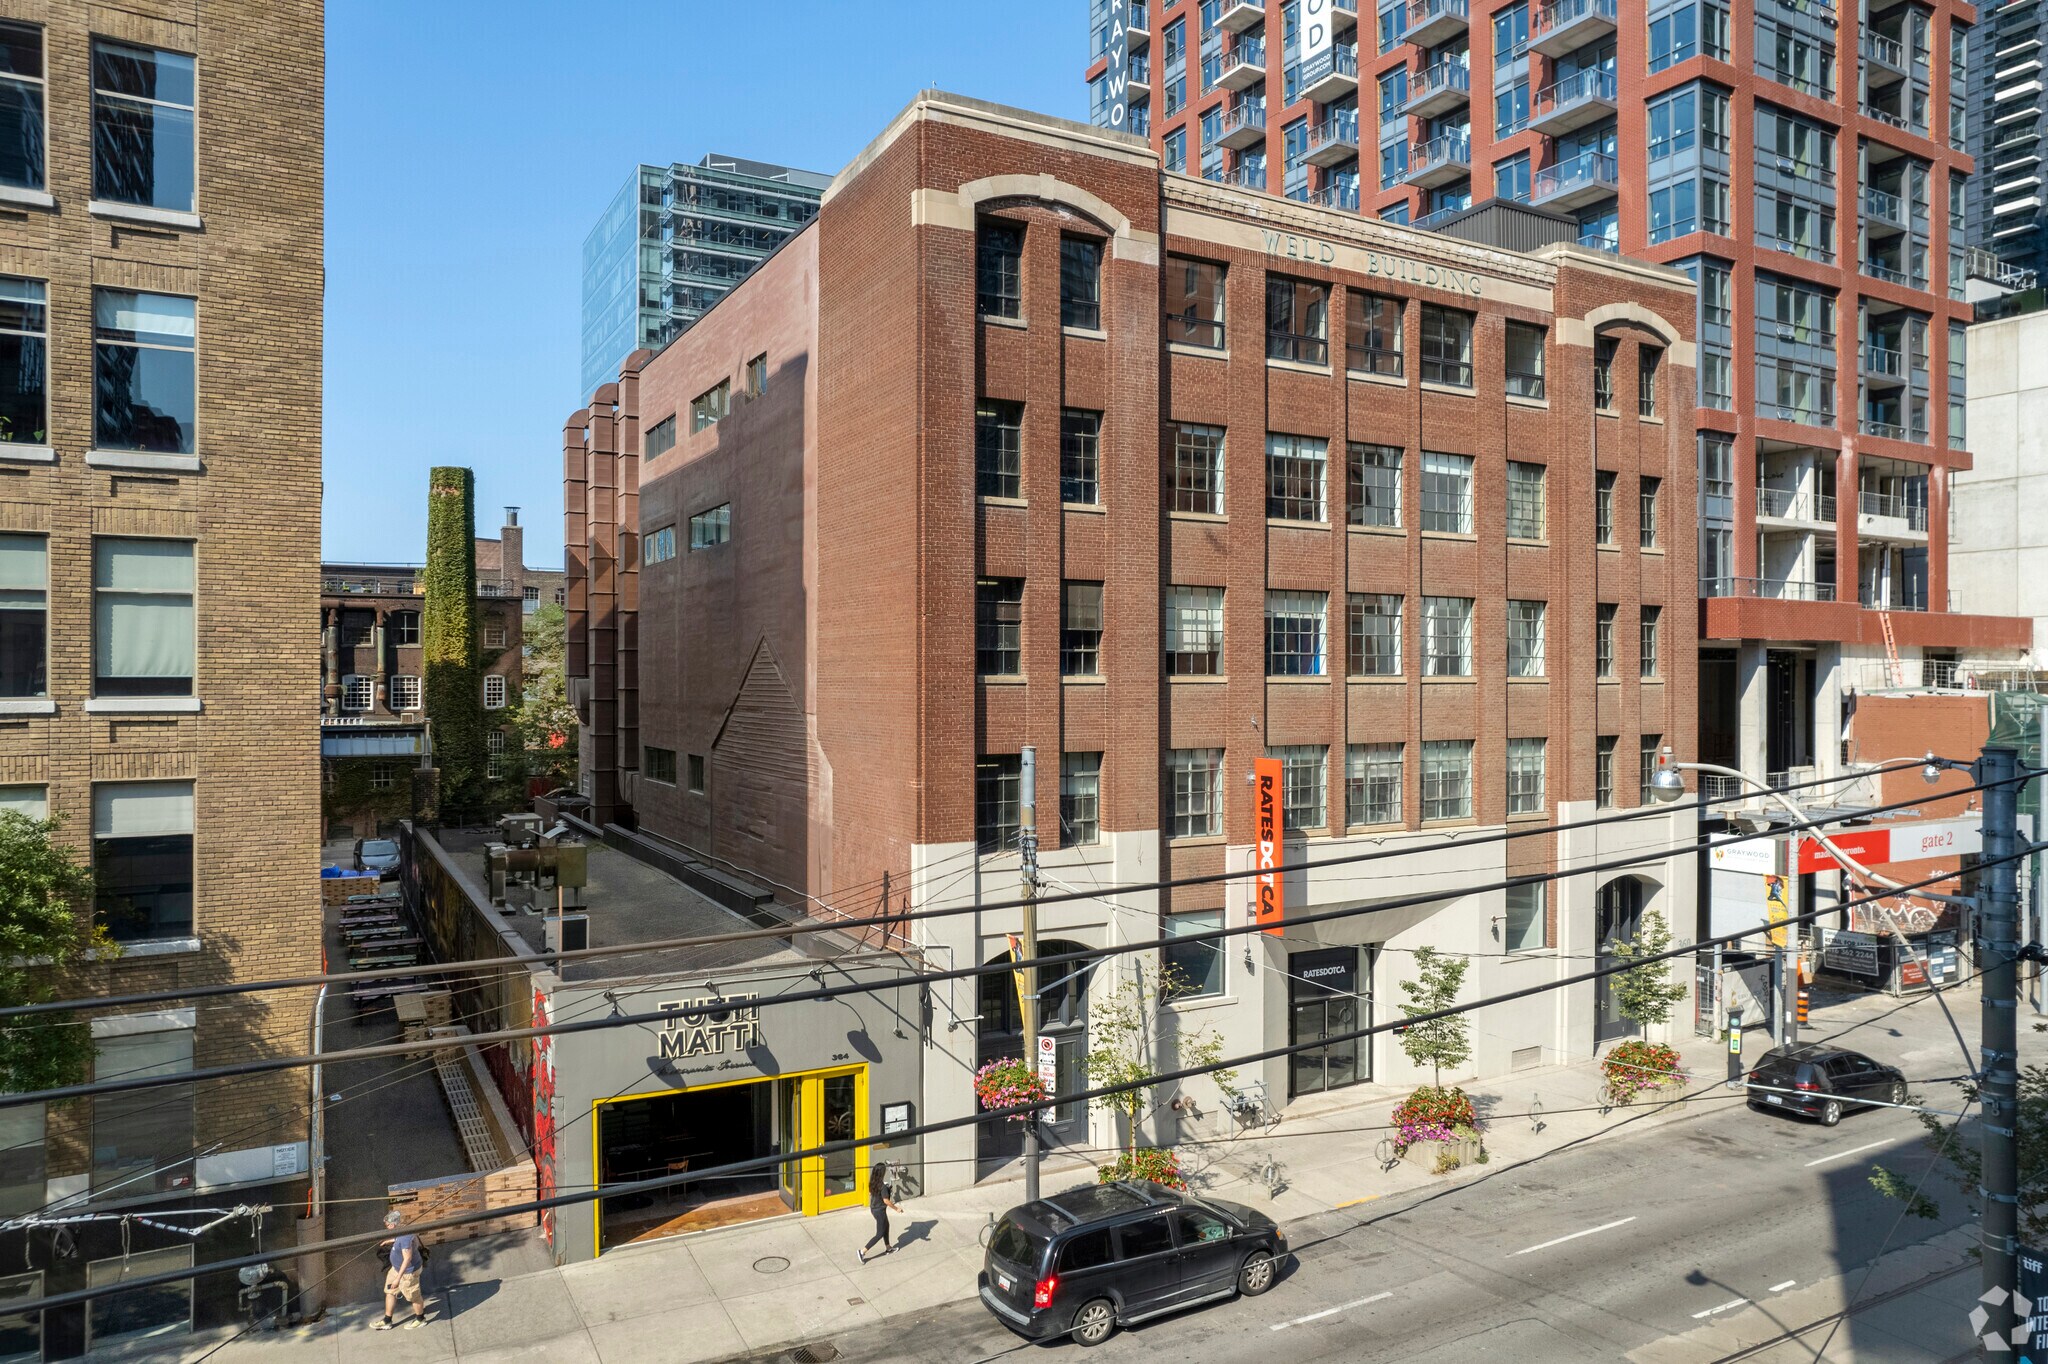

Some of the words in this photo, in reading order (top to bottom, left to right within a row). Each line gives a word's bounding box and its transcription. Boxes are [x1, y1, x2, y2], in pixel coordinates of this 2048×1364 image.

[1303, 53, 1331, 74] GRAYWOOD
[1261, 230, 1335, 263] WELD
[1368, 253, 1482, 295] BUILDING
[1260, 775, 1274, 916] RATESDOTCA
[1921, 834, 1944, 853] gate
[1946, 831, 1953, 846] 2
[1726, 848, 1770, 859] GRAYWOOD
[1303, 965, 1346, 979] RATESDOTCA
[658, 1020, 760, 1060] MATTI
[831, 1053, 849, 1061] 364
[2022, 1256, 2043, 1274] tiff
